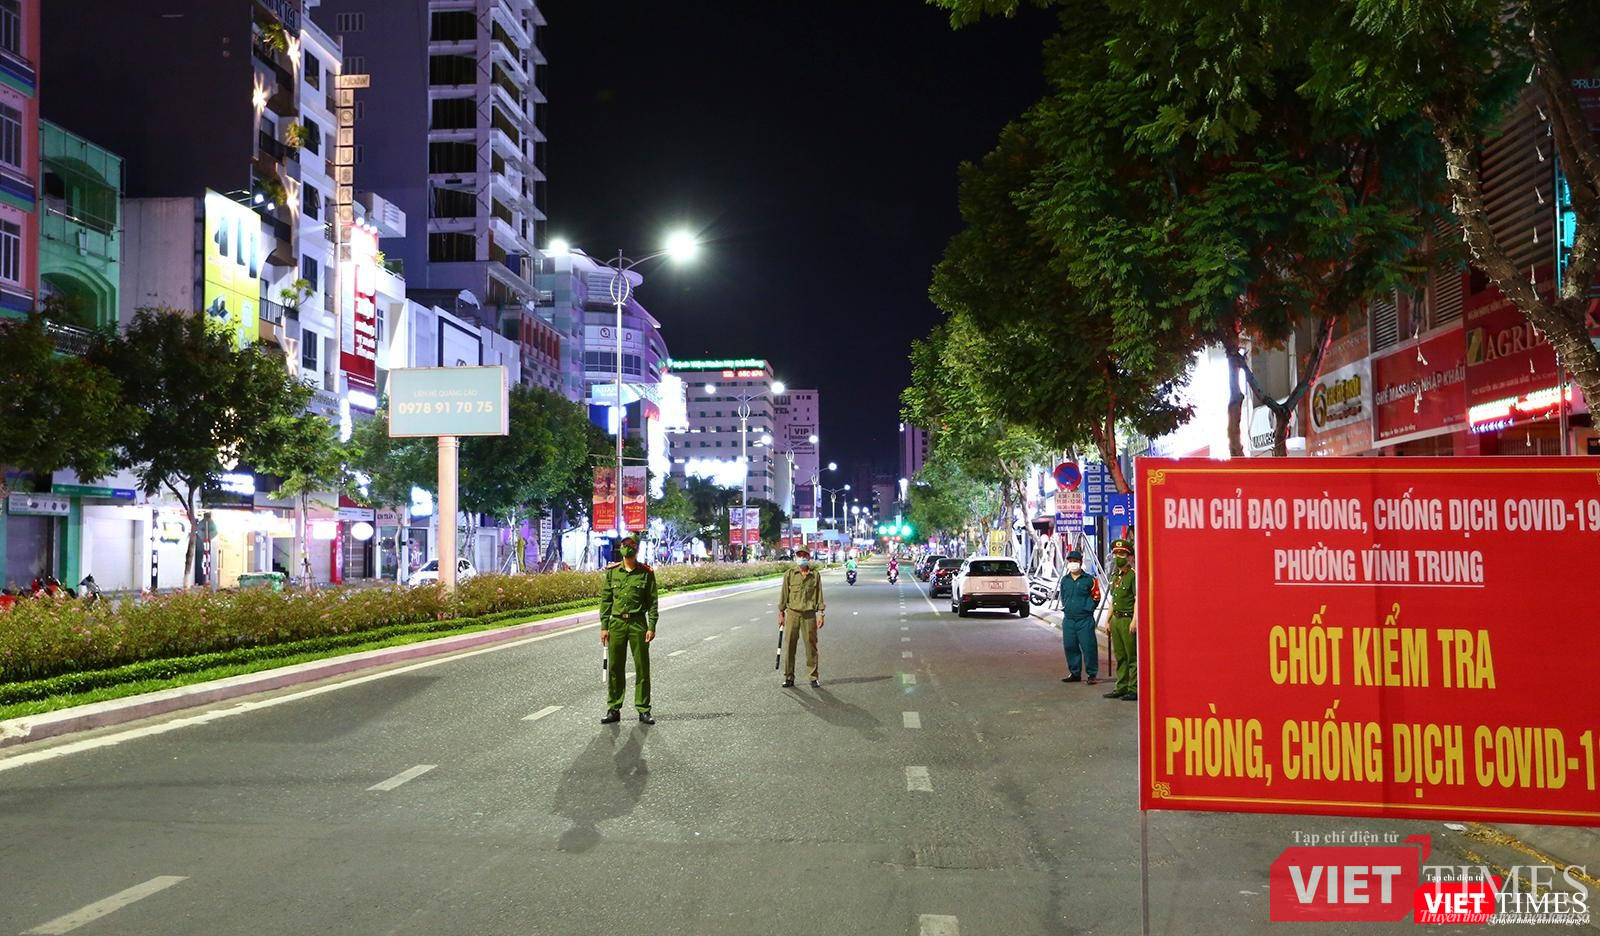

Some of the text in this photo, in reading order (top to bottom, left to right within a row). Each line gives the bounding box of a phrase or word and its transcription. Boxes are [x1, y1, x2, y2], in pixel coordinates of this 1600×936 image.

[399, 401, 493, 414] 0978 91 70 75
[1389, 380, 1420, 402] MASSAG
[1165, 487, 1600, 538] BAN CHỈ ĐẠO PHÒNG, CHỐNG DỊCH COVID-19
[1274, 542, 1484, 584] PHƯỜNG VĨNH TRUNG
[1269, 602, 1496, 689] CHỐT KIỂM TRA
[1165, 699, 1600, 798] PHÒNG, CHỐNG DỊCH COVID-1
